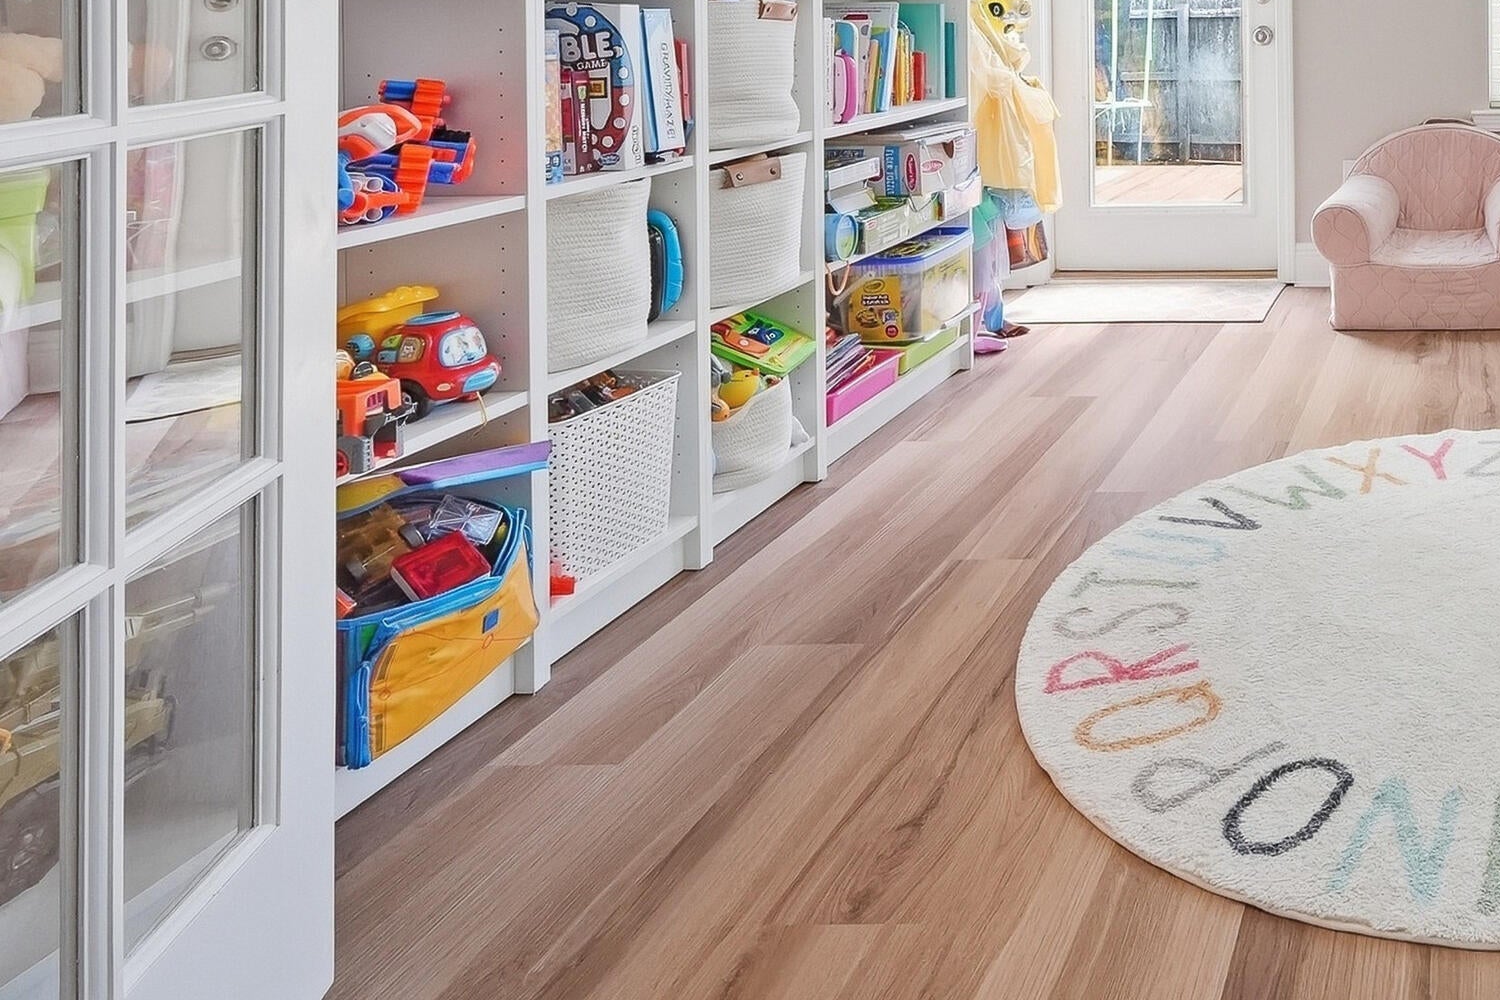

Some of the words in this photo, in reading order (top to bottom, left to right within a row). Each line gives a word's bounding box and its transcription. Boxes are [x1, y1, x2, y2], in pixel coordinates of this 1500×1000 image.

[576, 58, 607, 70] GAME
[1324, 446, 1410, 495] X
[1400, 437, 1454, 482] Y
[1248, 463, 1347, 511] W
[1157, 495, 1263, 533] V
[1111, 527, 1231, 570] U
[1069, 567, 1199, 601] T
[1052, 601, 1191, 643] S
[1043, 641, 1201, 697] R
[1071, 678, 1225, 753] Q
[1130, 739, 1288, 814] P
[1221, 756, 1356, 856] O
[1328, 776, 1465, 904] N
